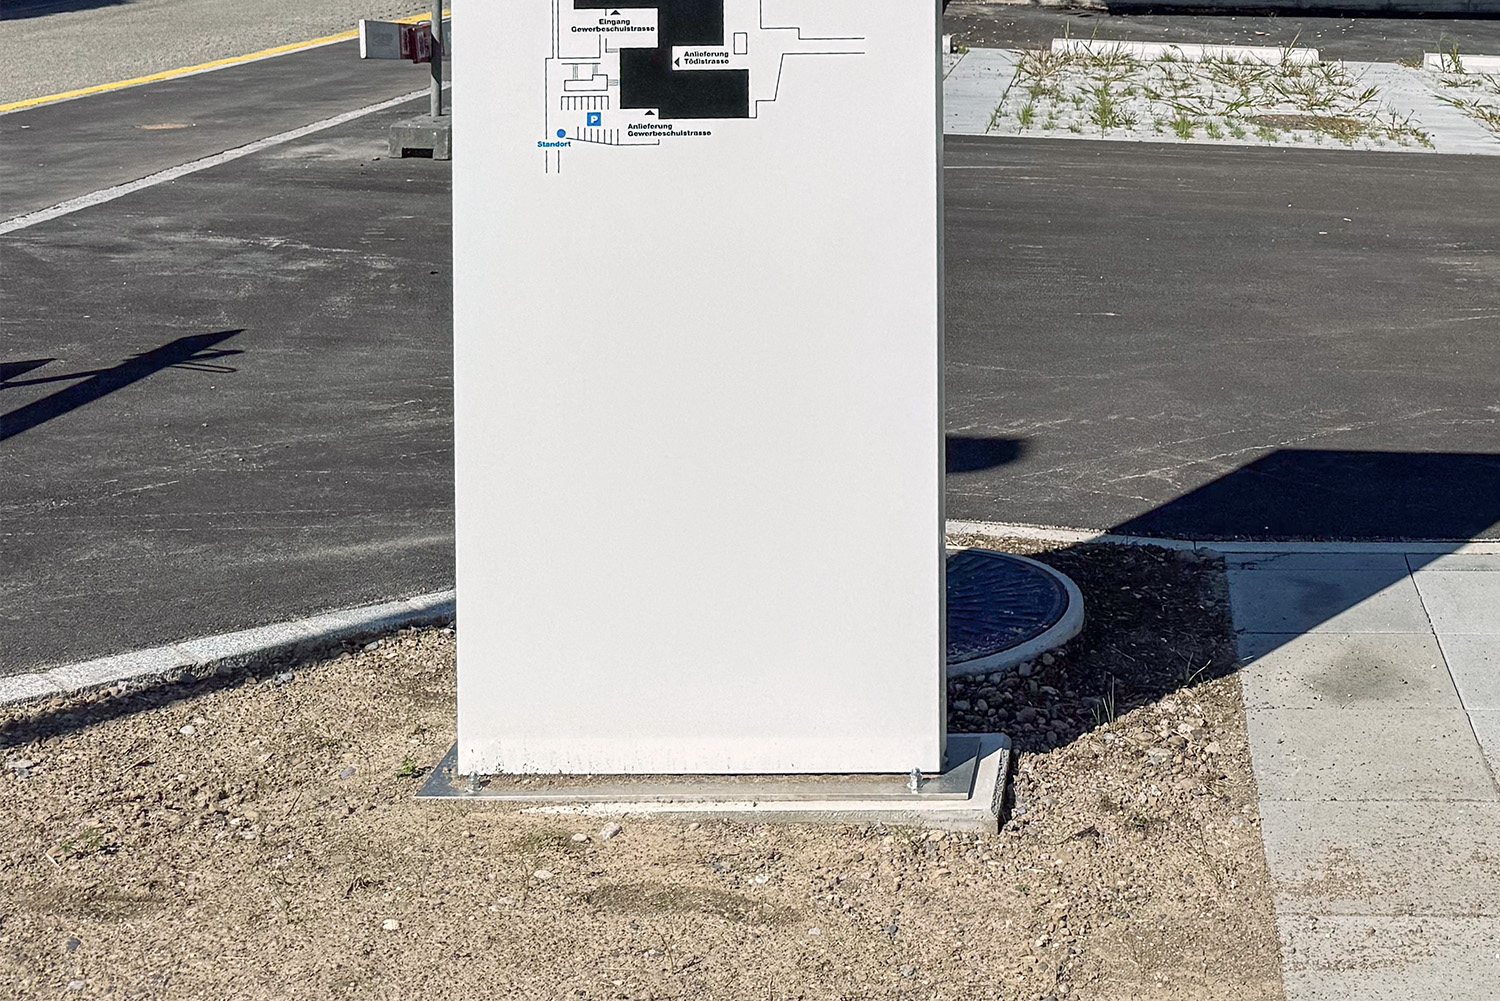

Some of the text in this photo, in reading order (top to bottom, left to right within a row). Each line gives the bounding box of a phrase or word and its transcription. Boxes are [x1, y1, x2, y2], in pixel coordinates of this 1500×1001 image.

[598, 18, 631, 27] Eingang
[570, 25, 656, 33] Gewerbeschulstrasse
[683, 50, 730, 60] Anlieferung
[683, 57, 730, 65] Tödistrasse
[627, 122, 673, 131] Anlieferung
[537, 140, 571, 148] Standort
